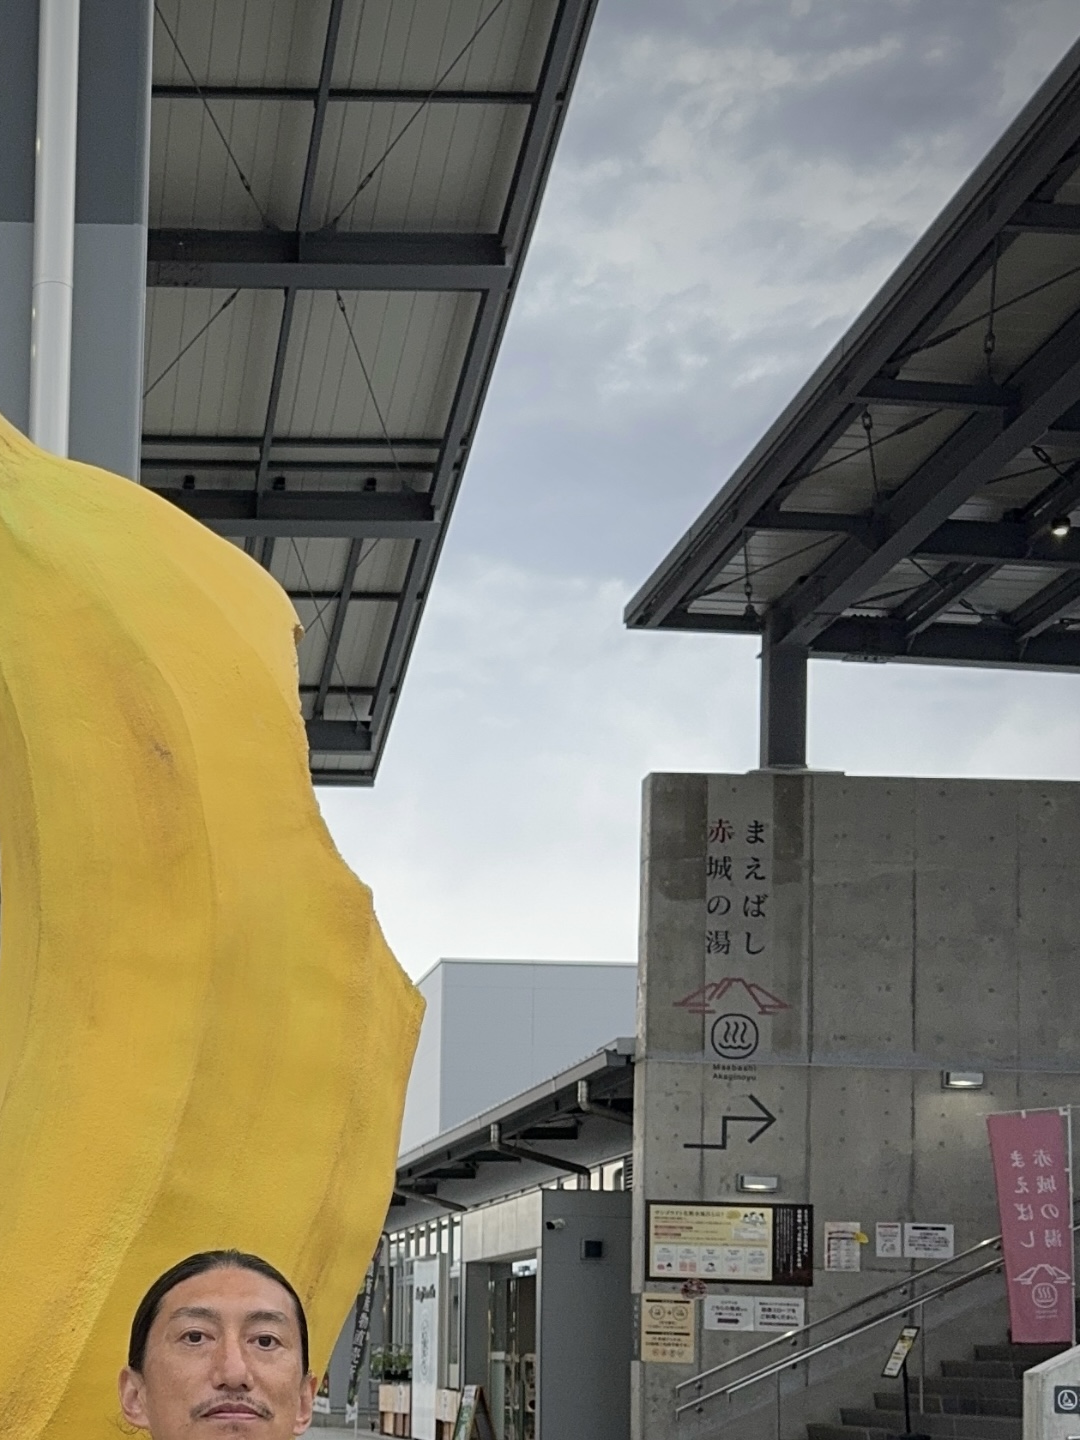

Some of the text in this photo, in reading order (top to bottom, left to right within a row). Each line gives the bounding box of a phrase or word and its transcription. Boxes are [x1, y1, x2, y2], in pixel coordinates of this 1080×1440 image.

[706, 818, 735, 955] 赤城の湯
[742, 820, 769, 955] まえばし
